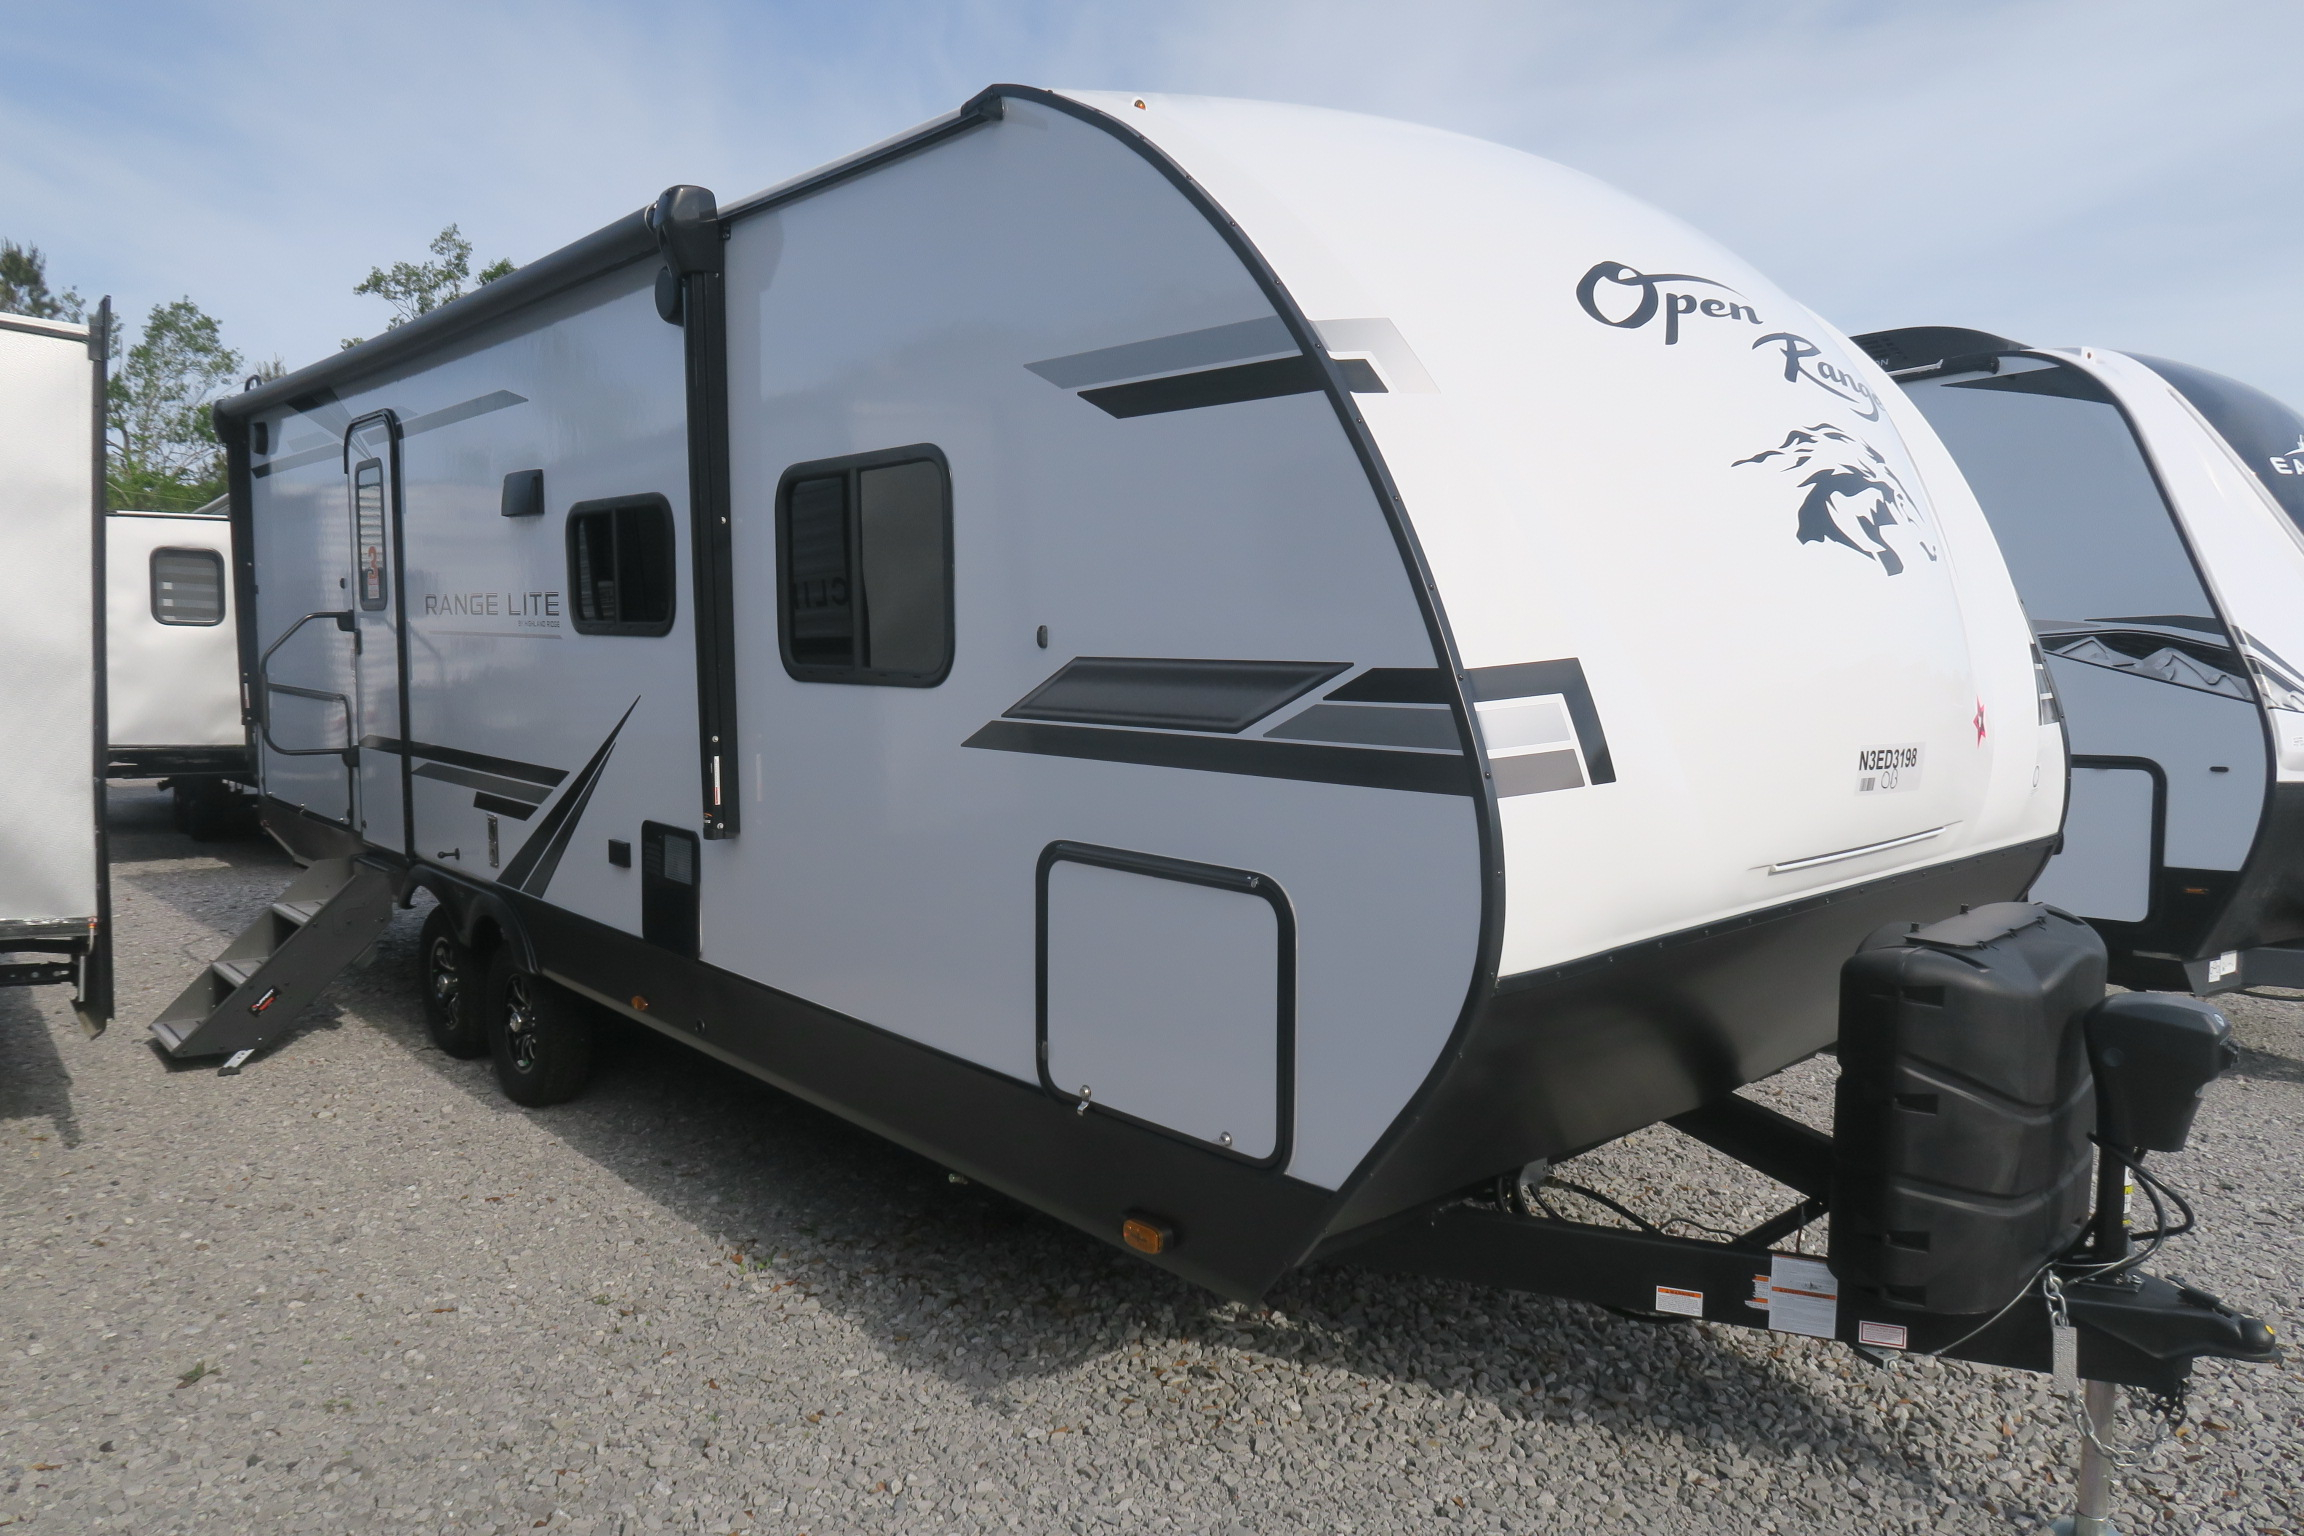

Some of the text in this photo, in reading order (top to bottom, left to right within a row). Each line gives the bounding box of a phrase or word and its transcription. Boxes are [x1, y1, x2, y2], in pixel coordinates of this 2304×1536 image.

[1576, 260, 1764, 345] Open
[425, 591, 560, 616] RANGE LITE
[1858, 748, 1918, 771] N3ED3198
